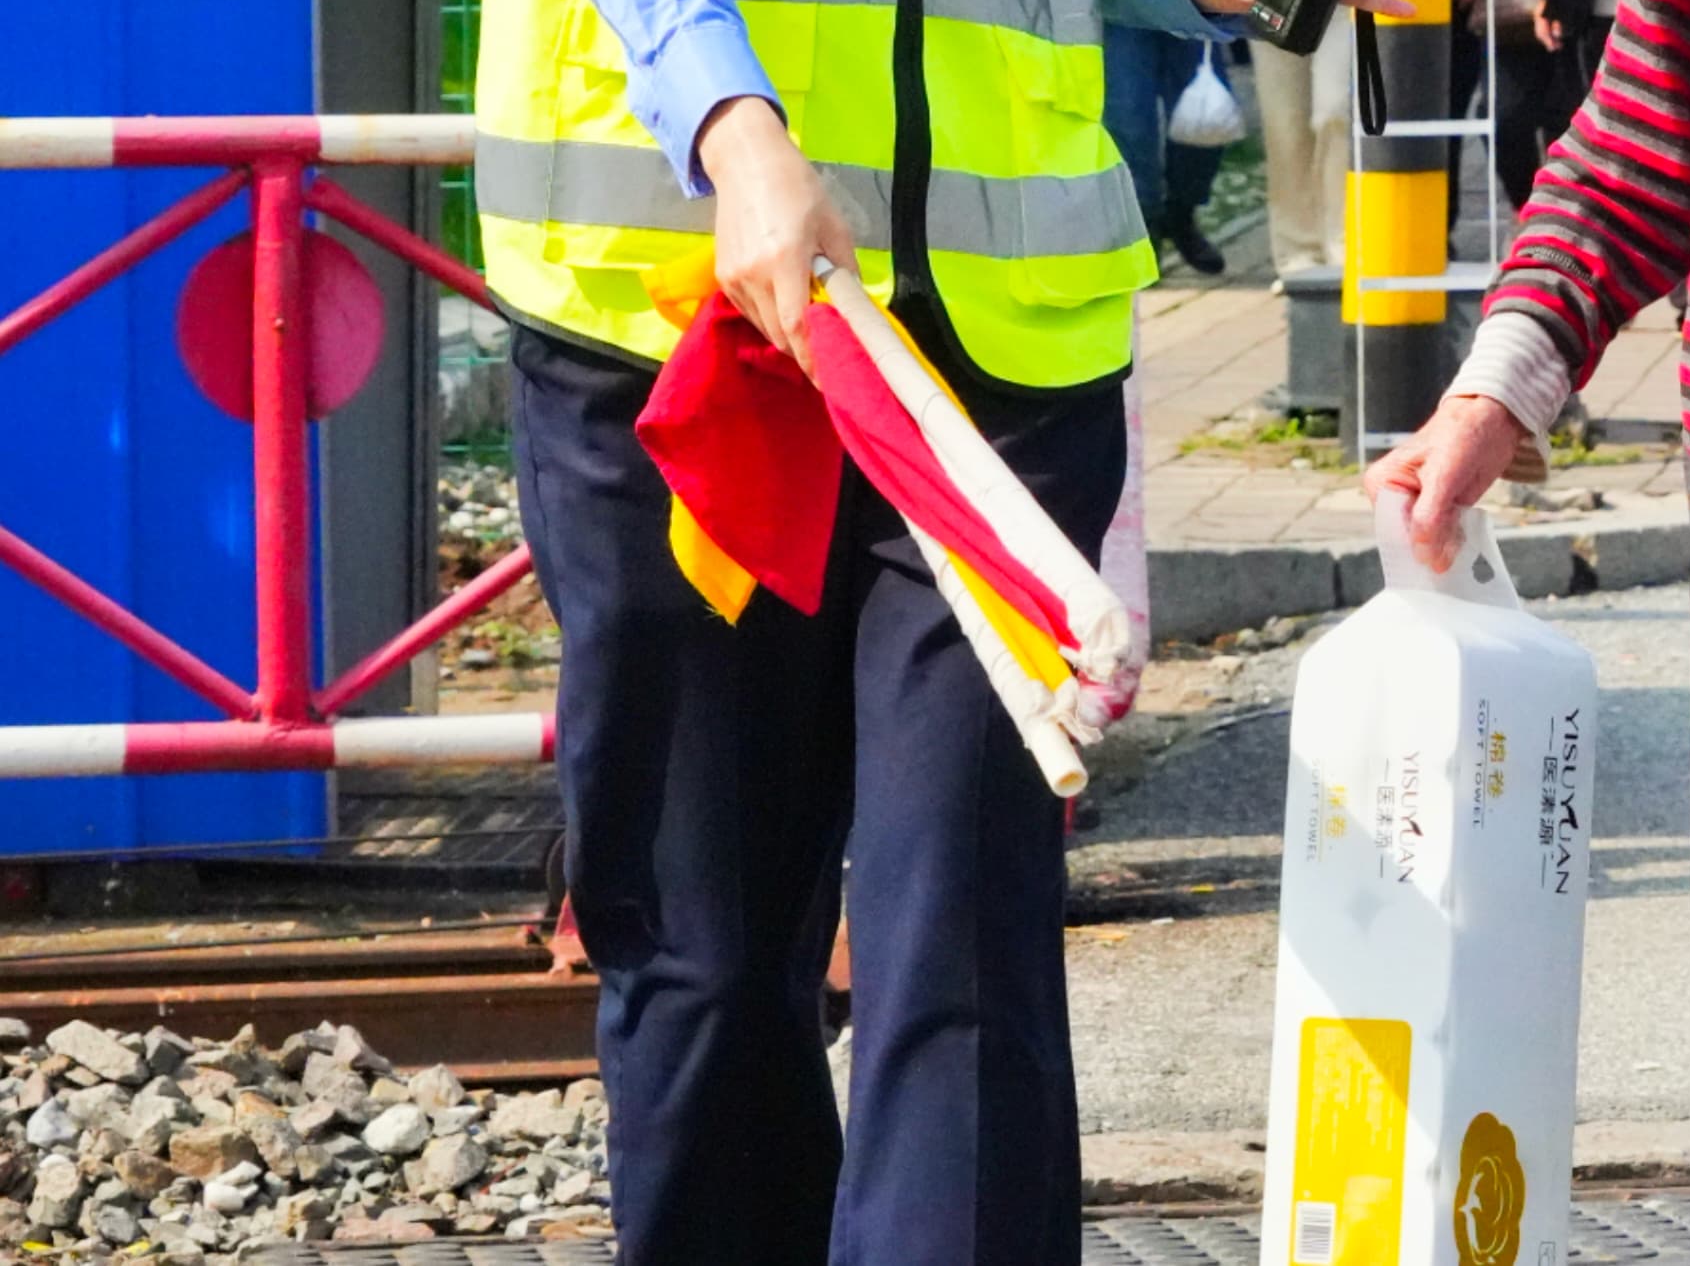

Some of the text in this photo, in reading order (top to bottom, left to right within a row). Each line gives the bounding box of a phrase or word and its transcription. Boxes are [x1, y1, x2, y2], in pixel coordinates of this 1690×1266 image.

[1397, 750, 1423, 884] YISUYUAN
[1472, 763, 1482, 827] TOWEL
[1554, 708, 1580, 895] YISUYUAN
